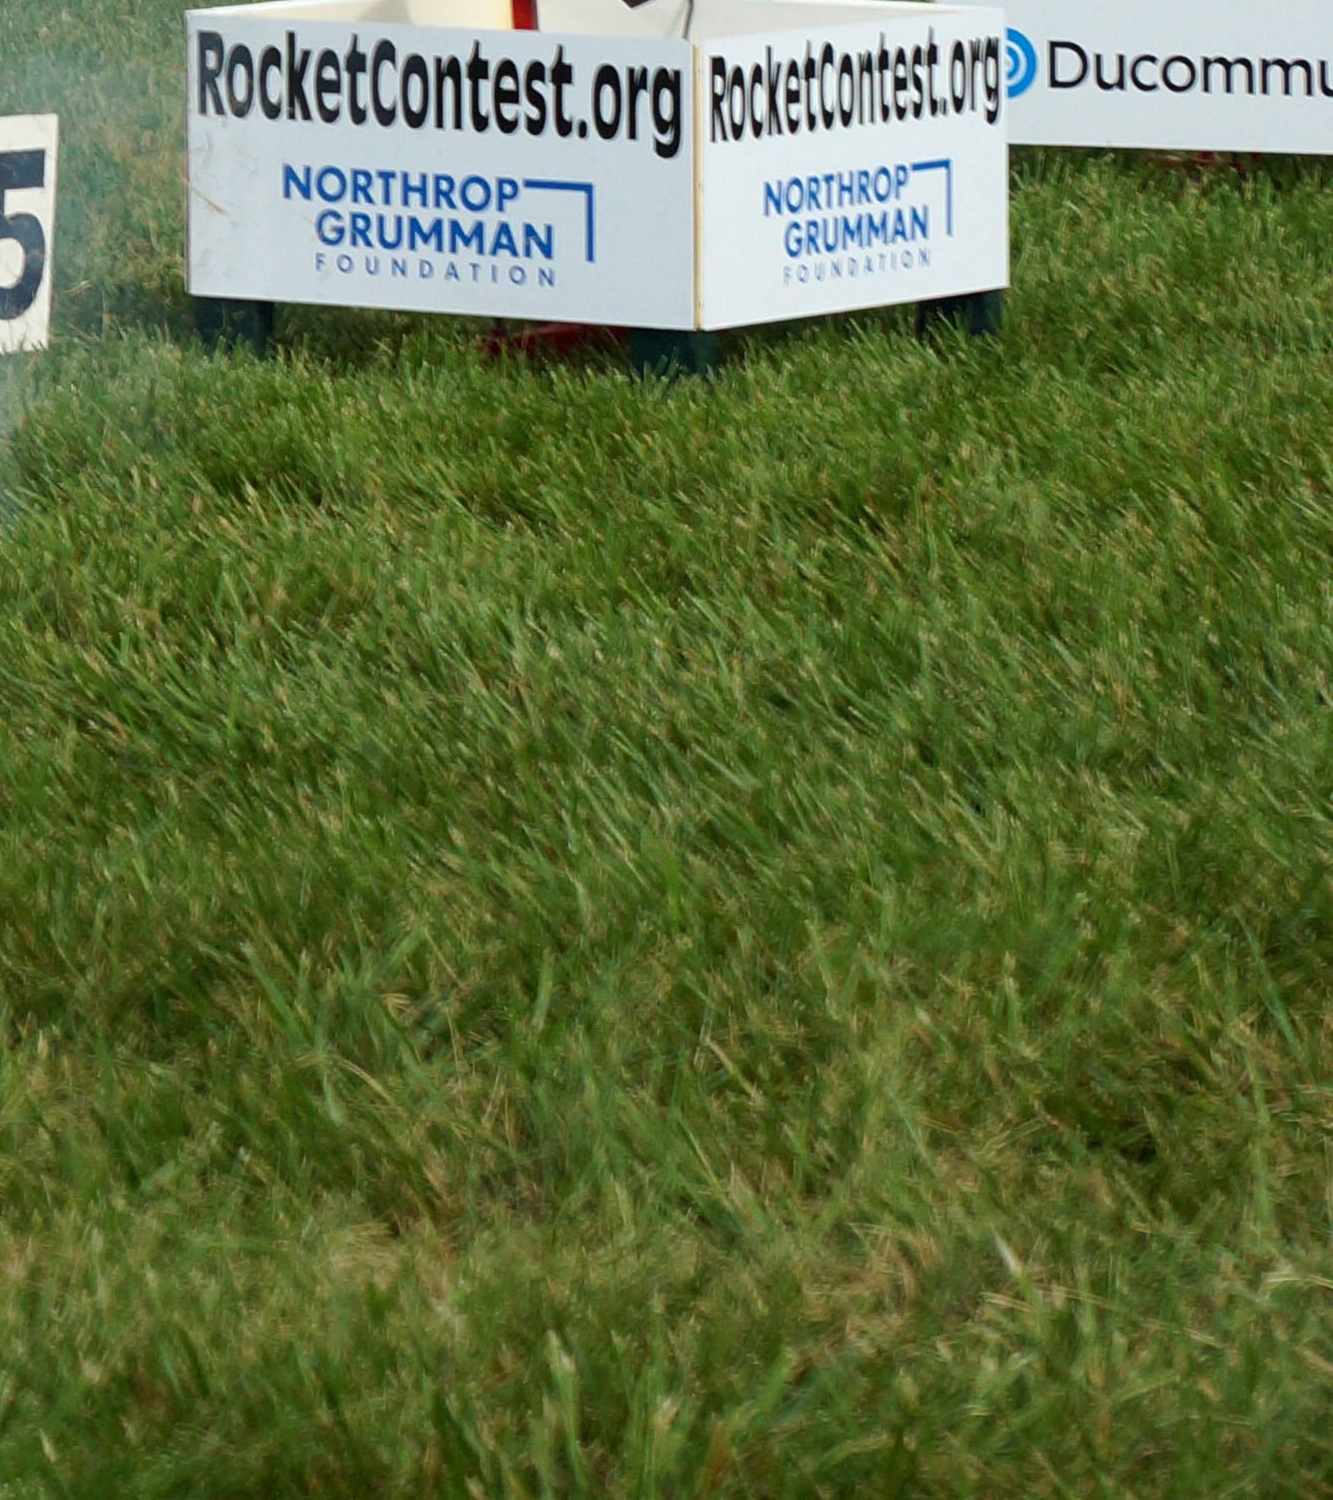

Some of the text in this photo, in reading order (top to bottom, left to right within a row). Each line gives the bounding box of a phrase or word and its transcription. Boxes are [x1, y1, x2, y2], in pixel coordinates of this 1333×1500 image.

[196, 29, 682, 160] RocketContest.org
[710, 28, 1000, 144] RocketContest.org
[282, 164, 521, 214] NORTHROP
[763, 164, 910, 217] NORTHROP
[316, 209, 555, 260] GRUMMAN
[784, 204, 930, 260] GRUMMAN
[314, 252, 557, 288] FOUNDATION
[783, 248, 932, 287] FOUNDATION
